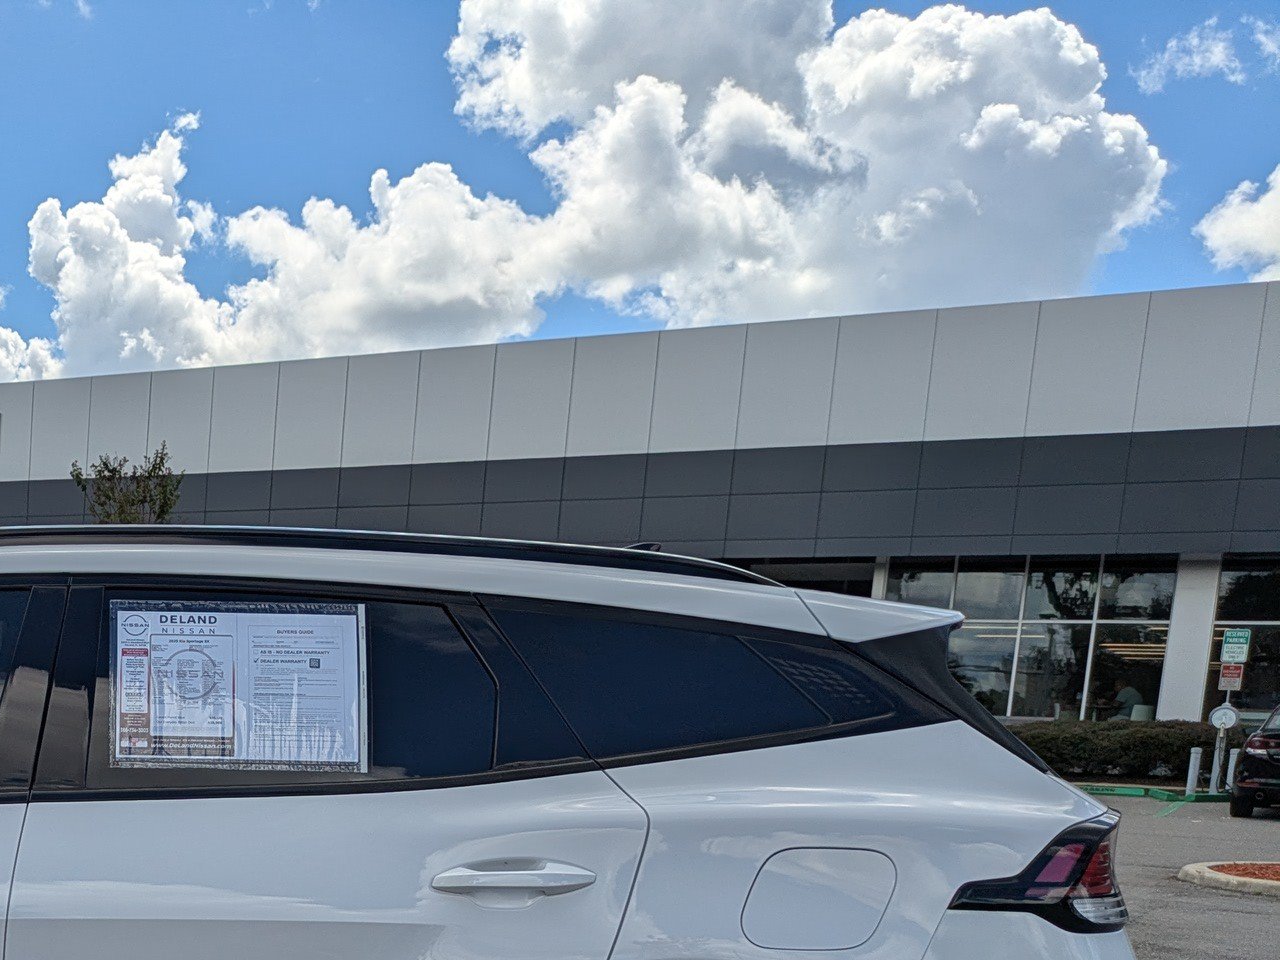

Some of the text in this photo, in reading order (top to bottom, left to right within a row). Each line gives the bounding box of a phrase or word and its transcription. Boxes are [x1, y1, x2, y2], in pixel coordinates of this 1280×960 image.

[159, 614, 217, 624] DELAND
[158, 669, 224, 678] NISSAN
[151, 742, 232, 750] www.DeLandNissan.com
